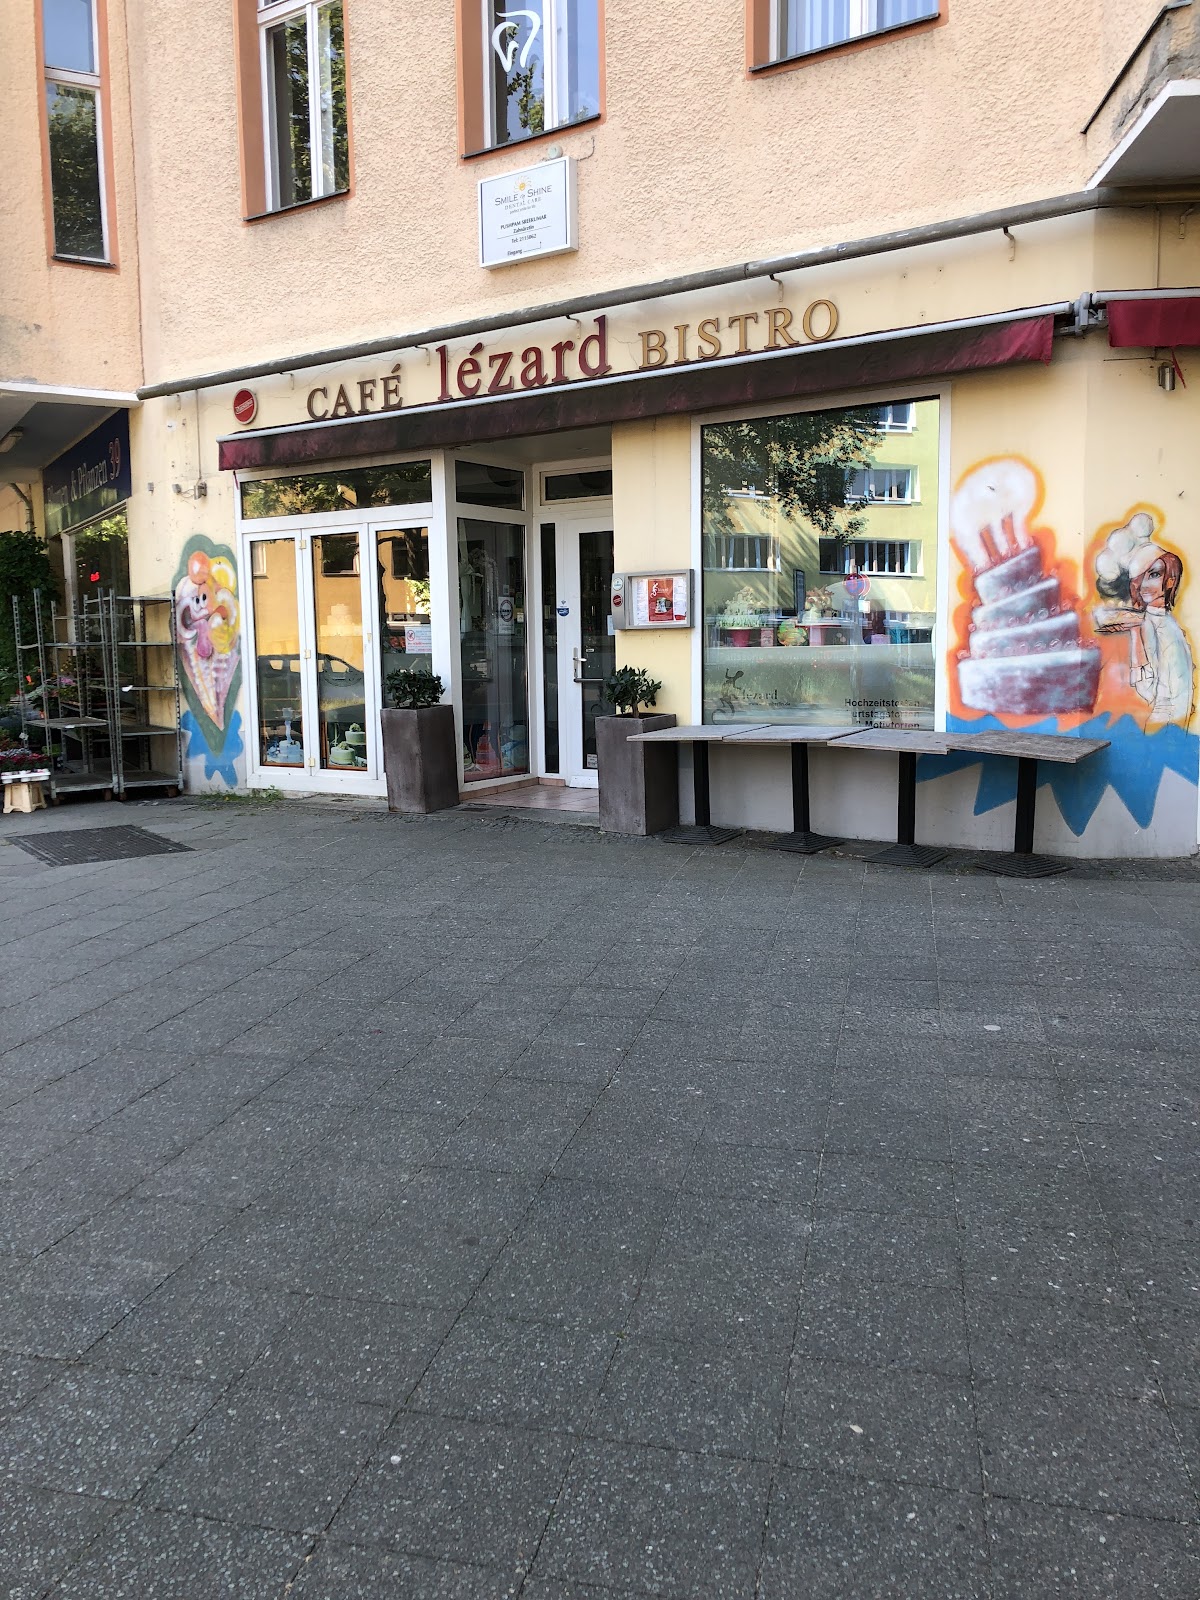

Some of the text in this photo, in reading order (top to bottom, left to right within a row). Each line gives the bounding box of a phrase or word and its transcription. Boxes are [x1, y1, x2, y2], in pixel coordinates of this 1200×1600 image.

[494, 193, 519, 206] SMILE
[527, 185, 552, 198] SHINE
[504, 196, 542, 211] DENTAL CARE
[307, 299, 840, 421] CAFÉ lézard BISTRO
[108, 437, 121, 480] 39
